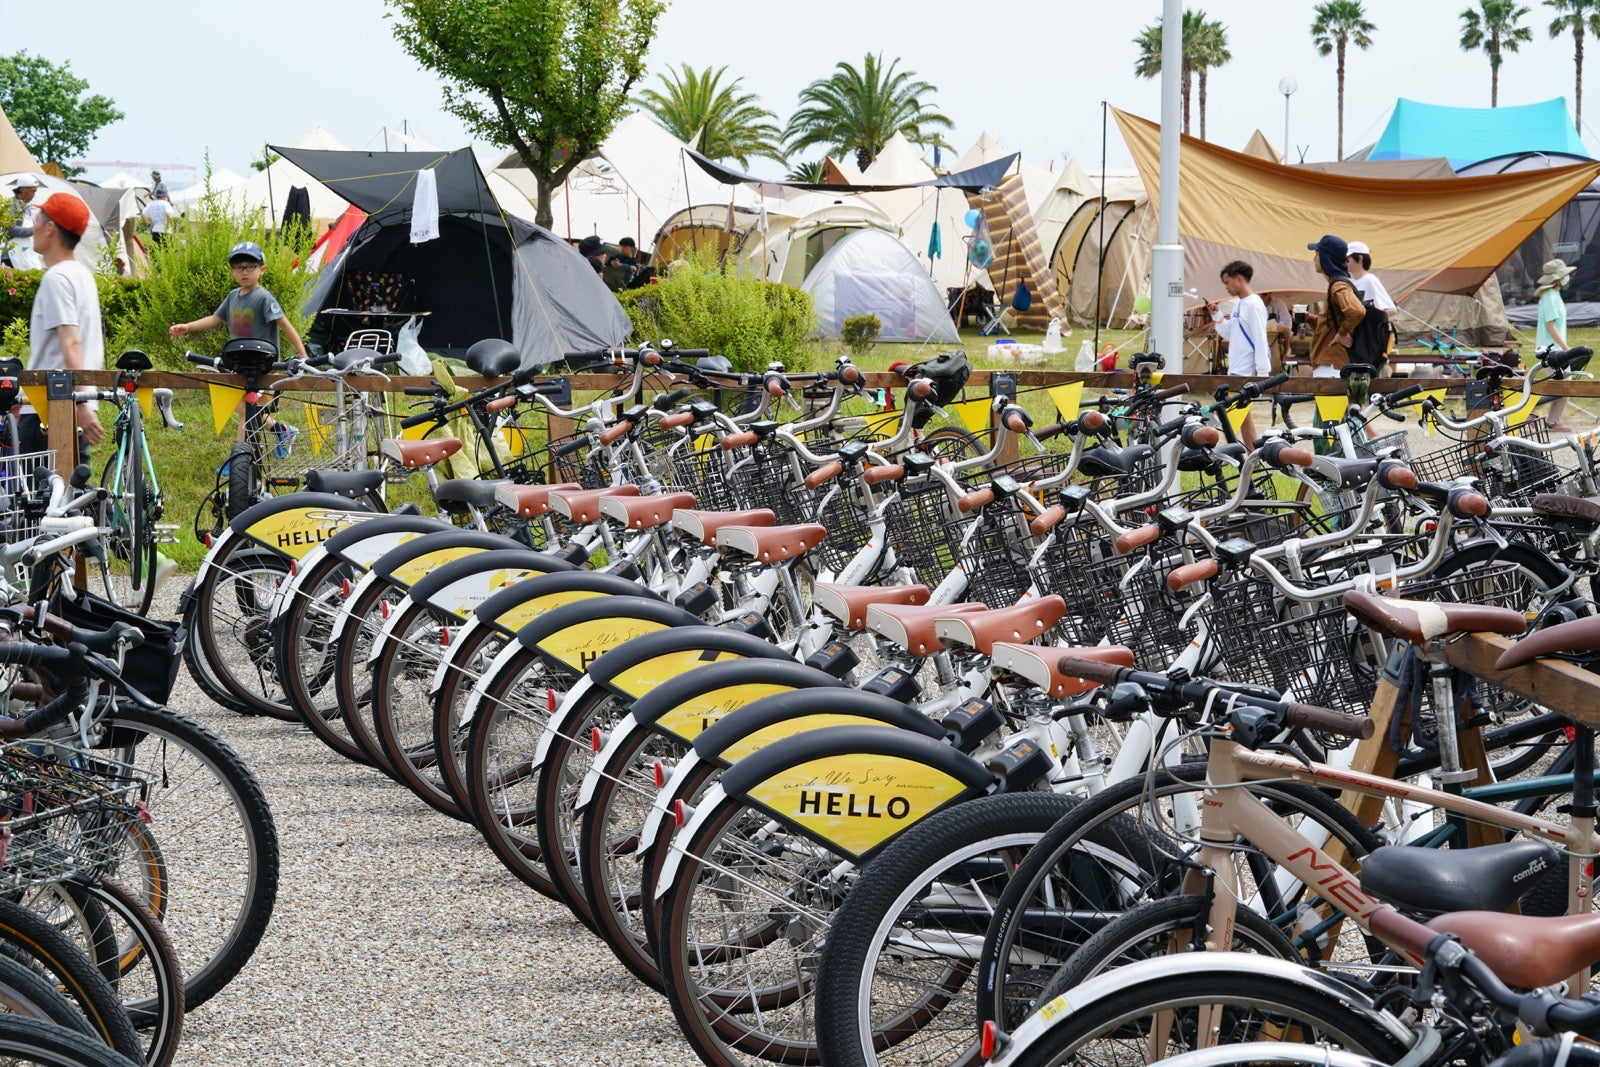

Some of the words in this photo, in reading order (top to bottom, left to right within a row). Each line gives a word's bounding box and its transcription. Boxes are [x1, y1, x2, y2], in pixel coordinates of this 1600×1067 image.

[783, 776, 819, 790] and
[825, 770, 854, 786] We
[858, 768, 897, 787] Say
[799, 790, 910, 820] HELLO
[1512, 860, 1548, 883] comfort
[993, 907, 1012, 958] SPEEDCROSS
